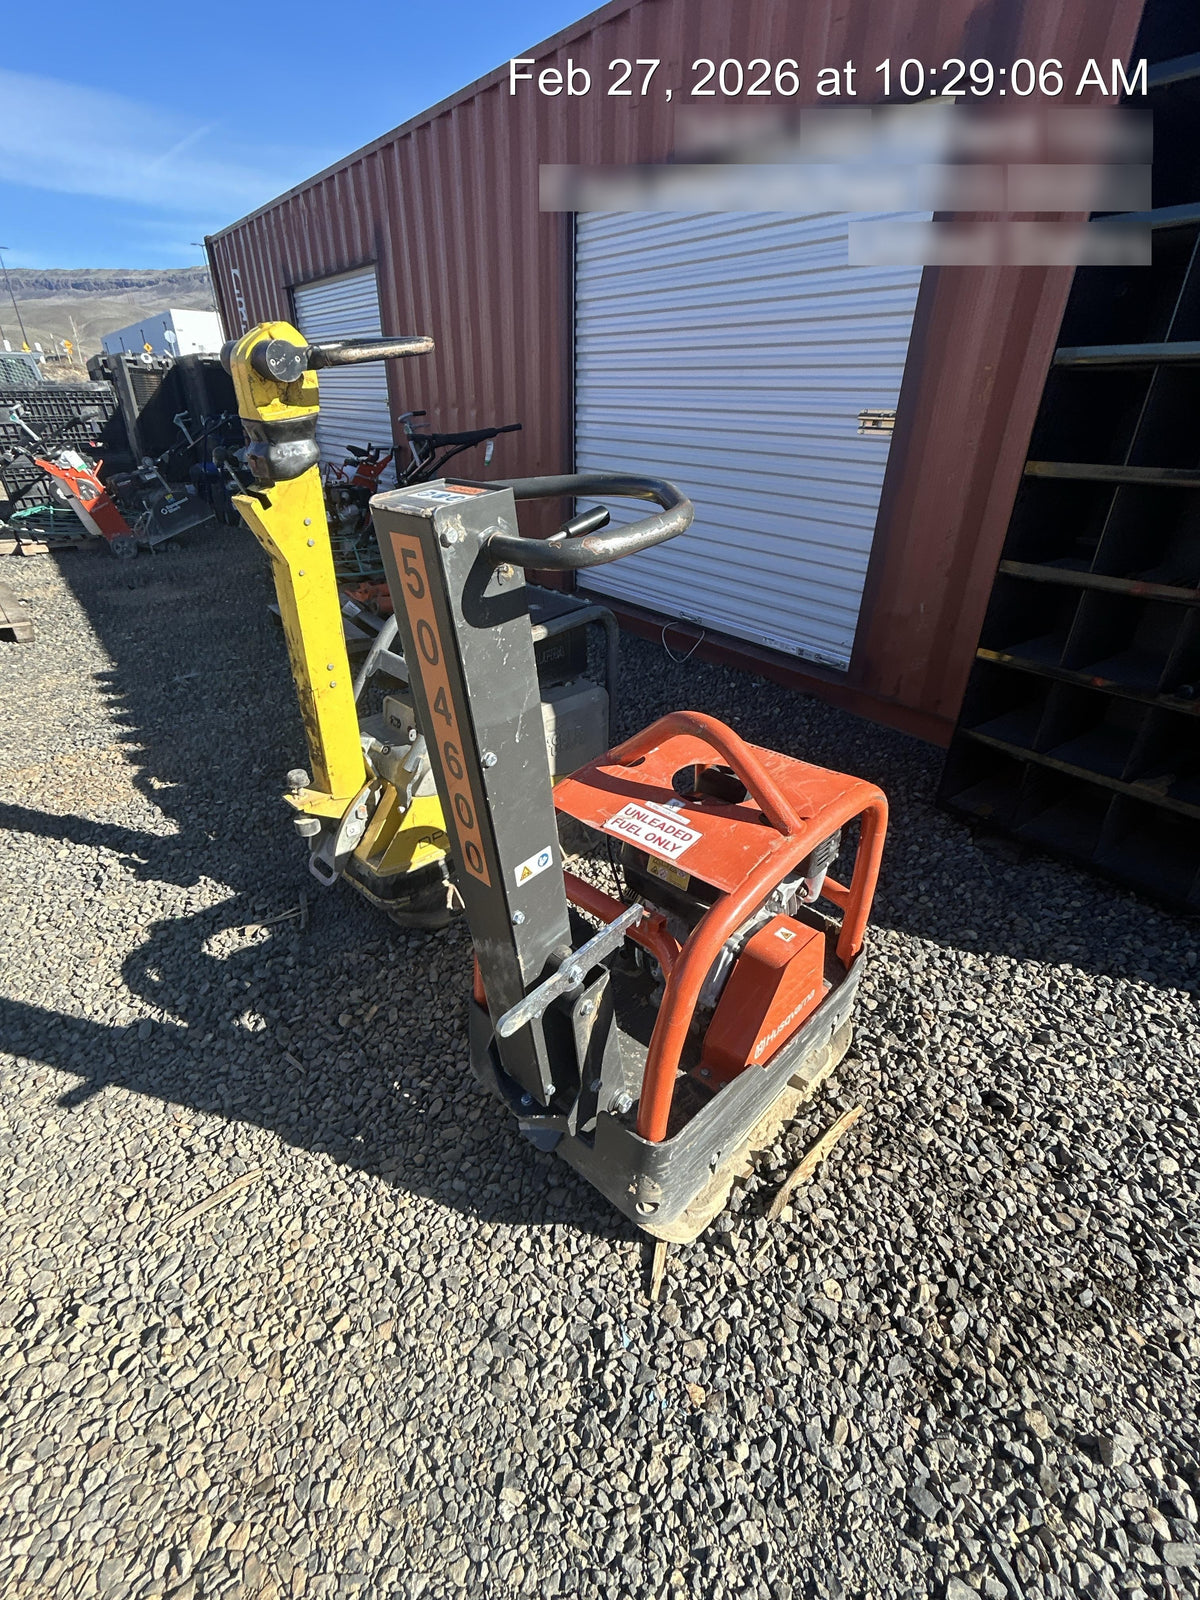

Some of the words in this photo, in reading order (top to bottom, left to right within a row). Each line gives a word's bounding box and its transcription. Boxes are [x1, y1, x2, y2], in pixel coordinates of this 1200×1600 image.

[401, 548, 484, 874] 504600
[418, 830, 448, 849] DP
[610, 817, 643, 837] FUEL
[644, 832, 683, 853] ONLY
[624, 807, 693, 842] UNLEADED
[764, 988, 816, 1047] Husqvarna
